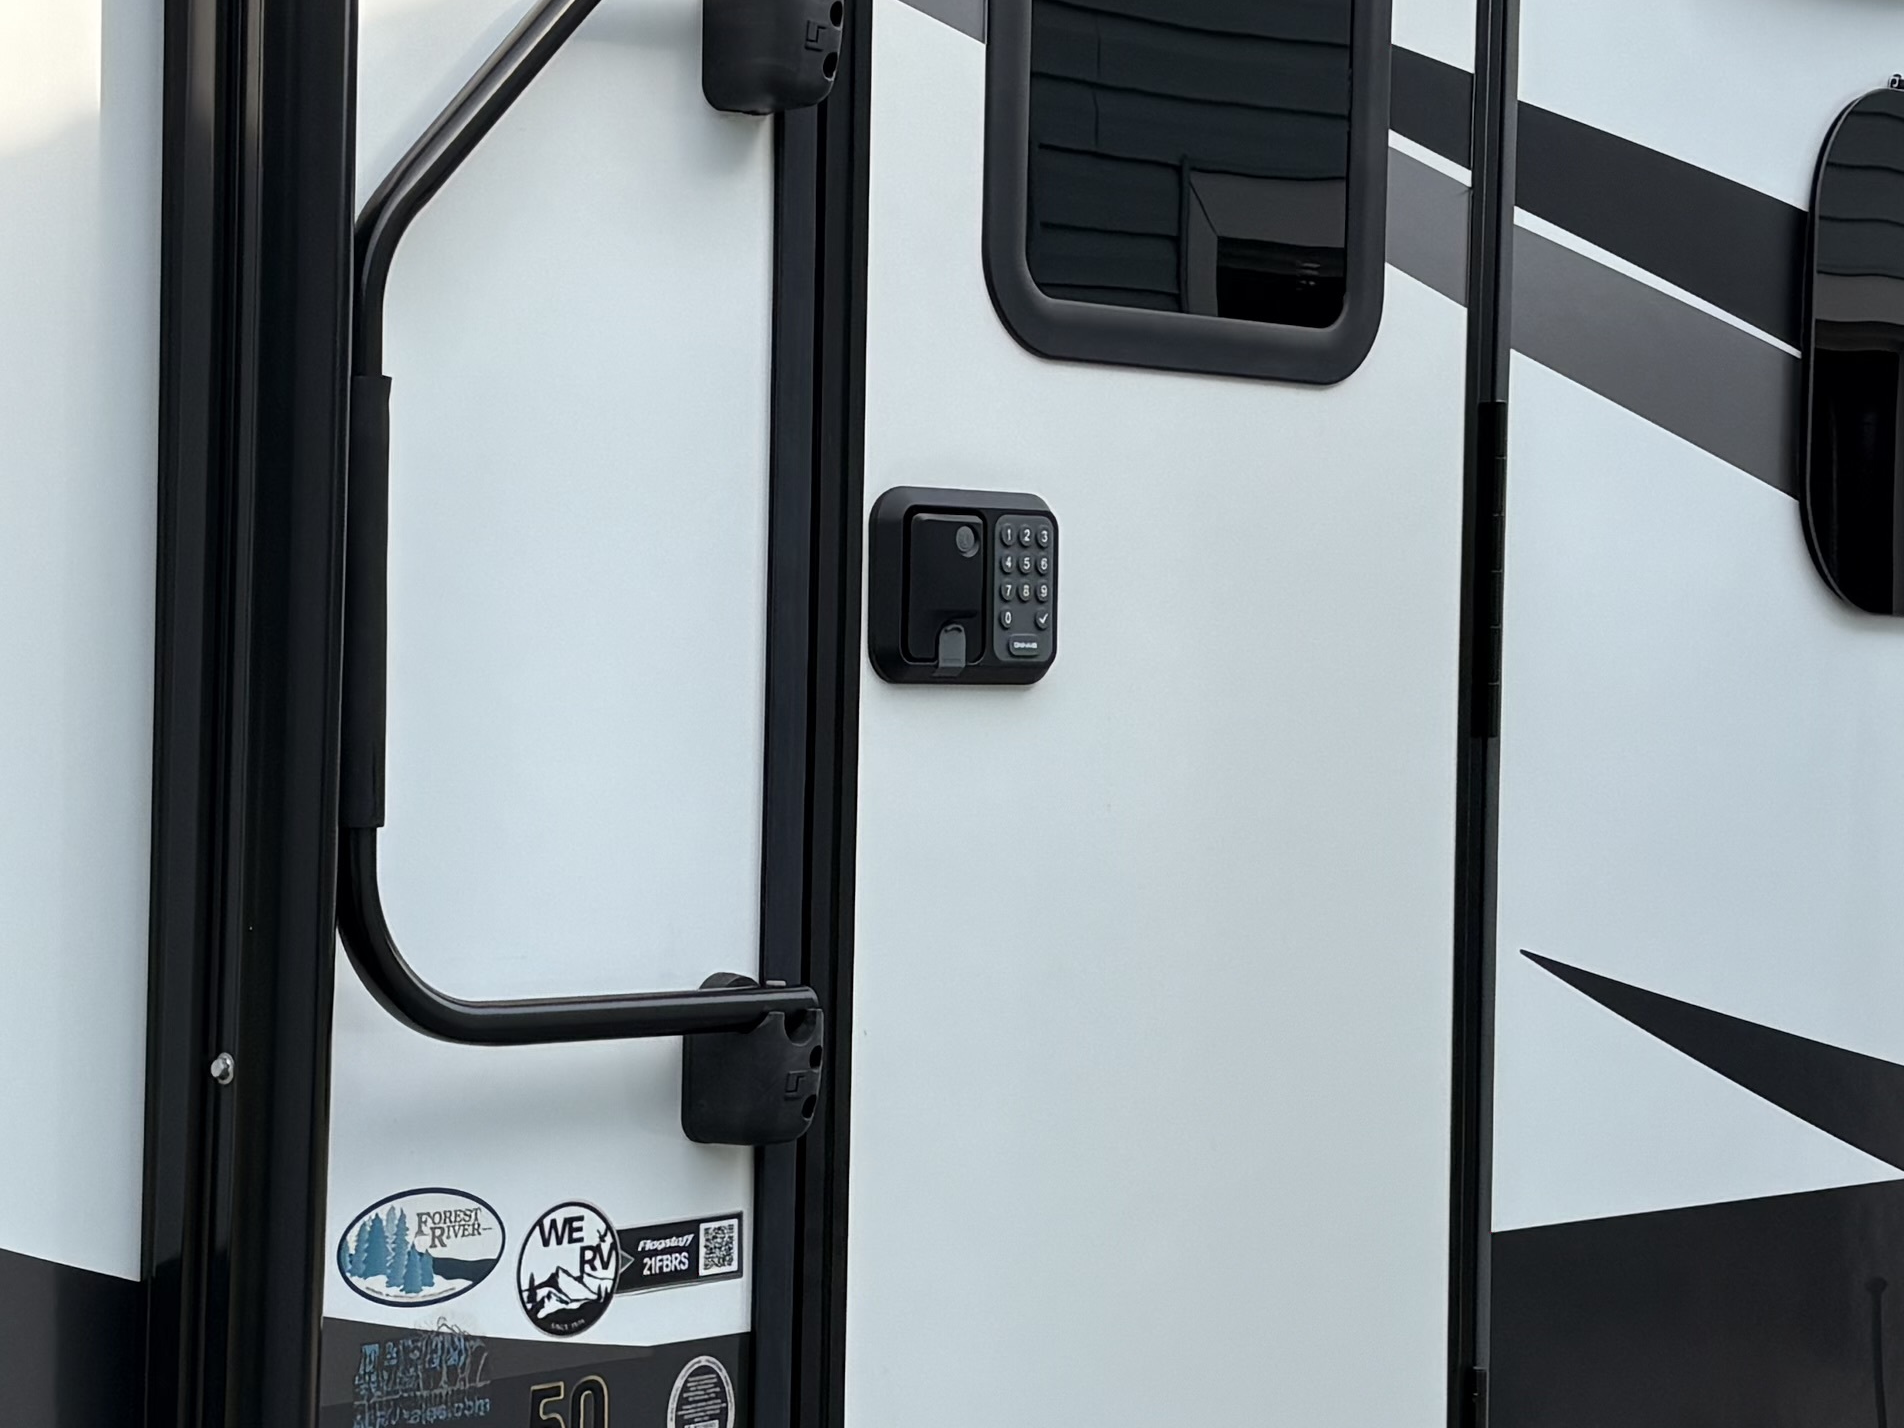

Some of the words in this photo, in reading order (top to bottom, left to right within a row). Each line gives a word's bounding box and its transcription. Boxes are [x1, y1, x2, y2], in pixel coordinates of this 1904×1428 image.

[1006, 529, 1012, 541] 1
[1023, 529, 1031, 542] 2
[1041, 530, 1048, 543] 3
[1005, 557, 1012, 569] 4
[1023, 558, 1031, 570] 5
[1040, 558, 1048, 570] 6
[1005, 585, 1012, 596] 7
[1022, 585, 1030, 597] 8
[1040, 585, 1048, 597] 9
[1004, 611, 1012, 624] 0
[414, 1207, 482, 1237] FOREST
[538, 1214, 585, 1248] WE
[428, 1222, 482, 1249] RIVER
[579, 1242, 617, 1277] RV
[642, 1252, 690, 1276] 21FBRS
